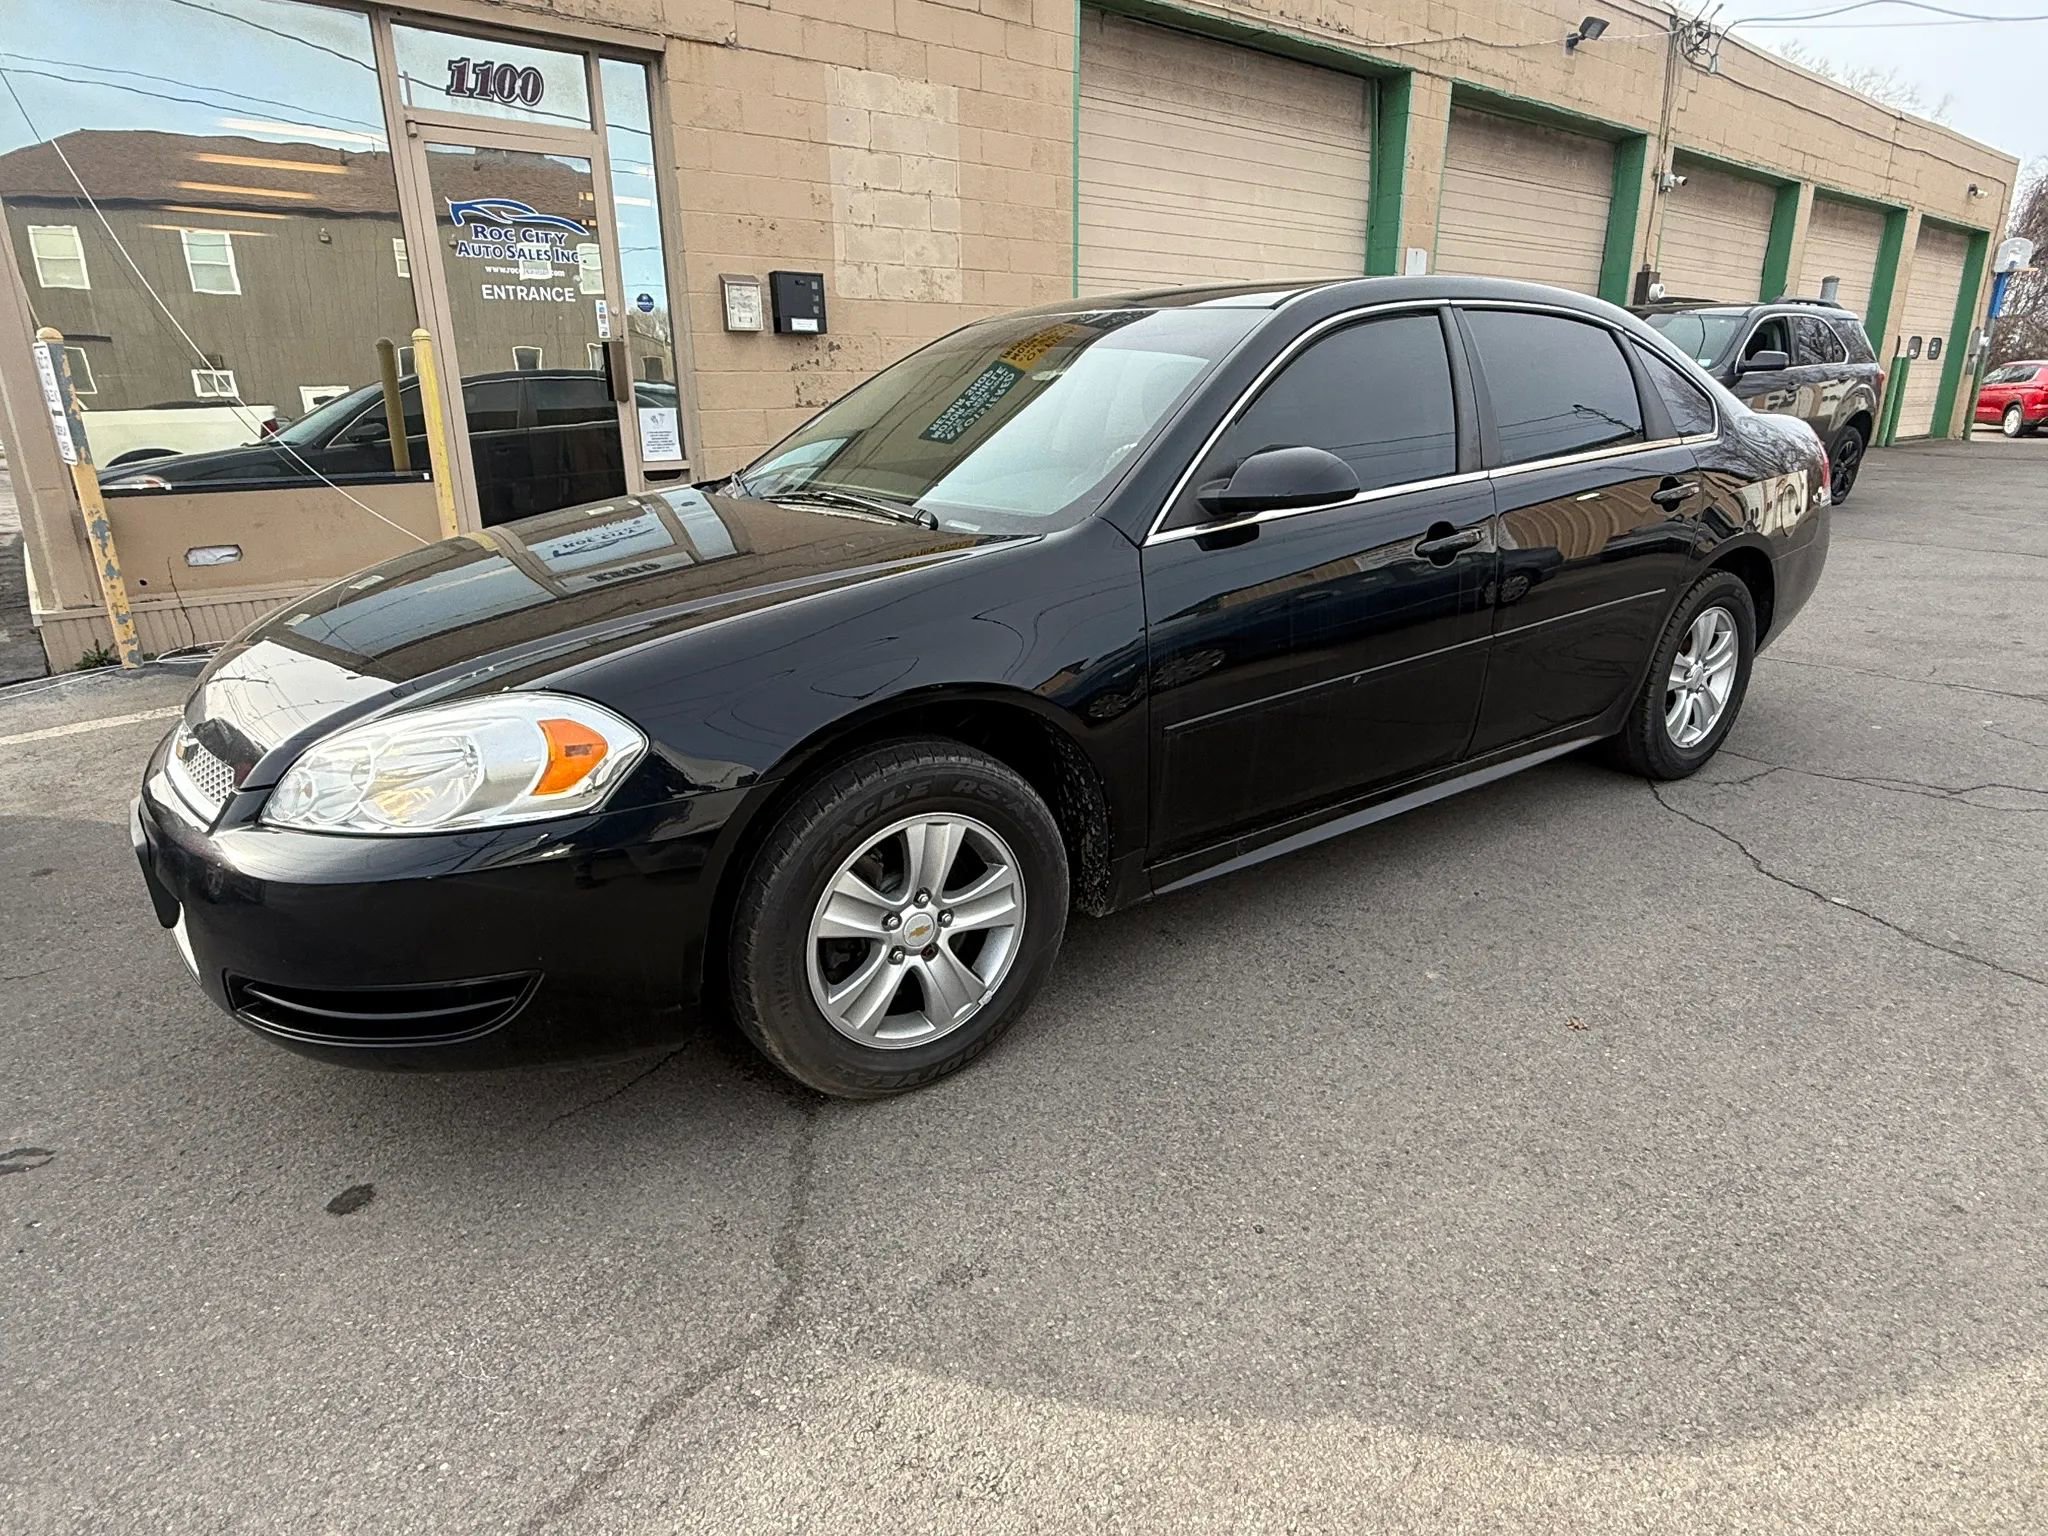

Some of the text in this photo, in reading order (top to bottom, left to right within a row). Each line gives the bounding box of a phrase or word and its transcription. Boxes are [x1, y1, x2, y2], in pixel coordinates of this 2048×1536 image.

[446, 57, 544, 106] 1100
[471, 223, 568, 246] ROC CITY
[456, 241, 503, 259] AUTO
[506, 244, 551, 262] SALES
[481, 284, 576, 302] ENTRANCE
